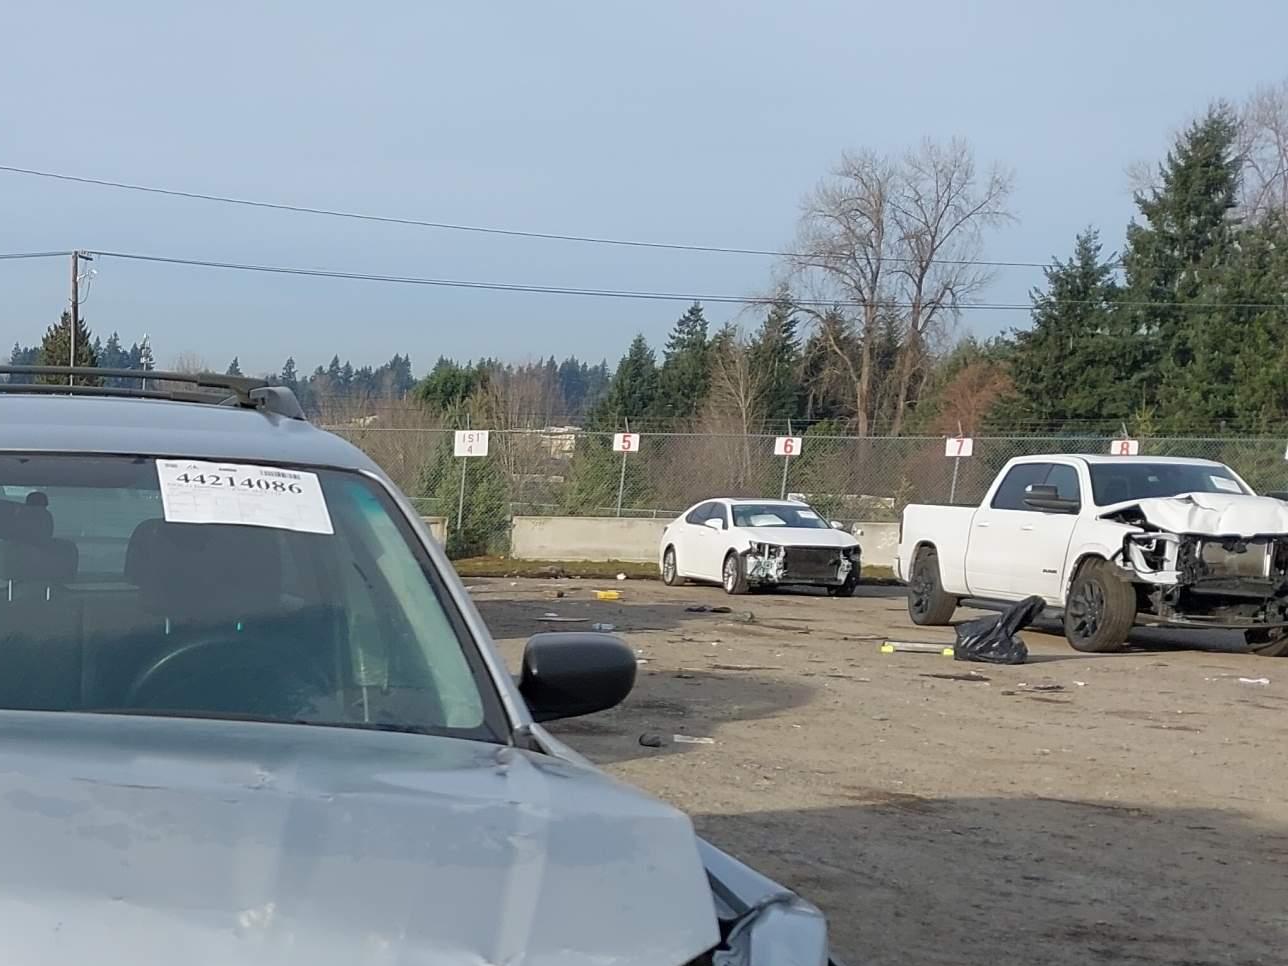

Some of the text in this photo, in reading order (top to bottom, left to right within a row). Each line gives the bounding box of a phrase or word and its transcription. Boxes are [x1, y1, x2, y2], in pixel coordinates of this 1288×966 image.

[622, 435, 632, 450] 5
[784, 439, 794, 454] 6
[956, 440, 965, 455] 7
[1120, 442, 1130, 455] 8
[176, 472, 303, 494] 44214086
